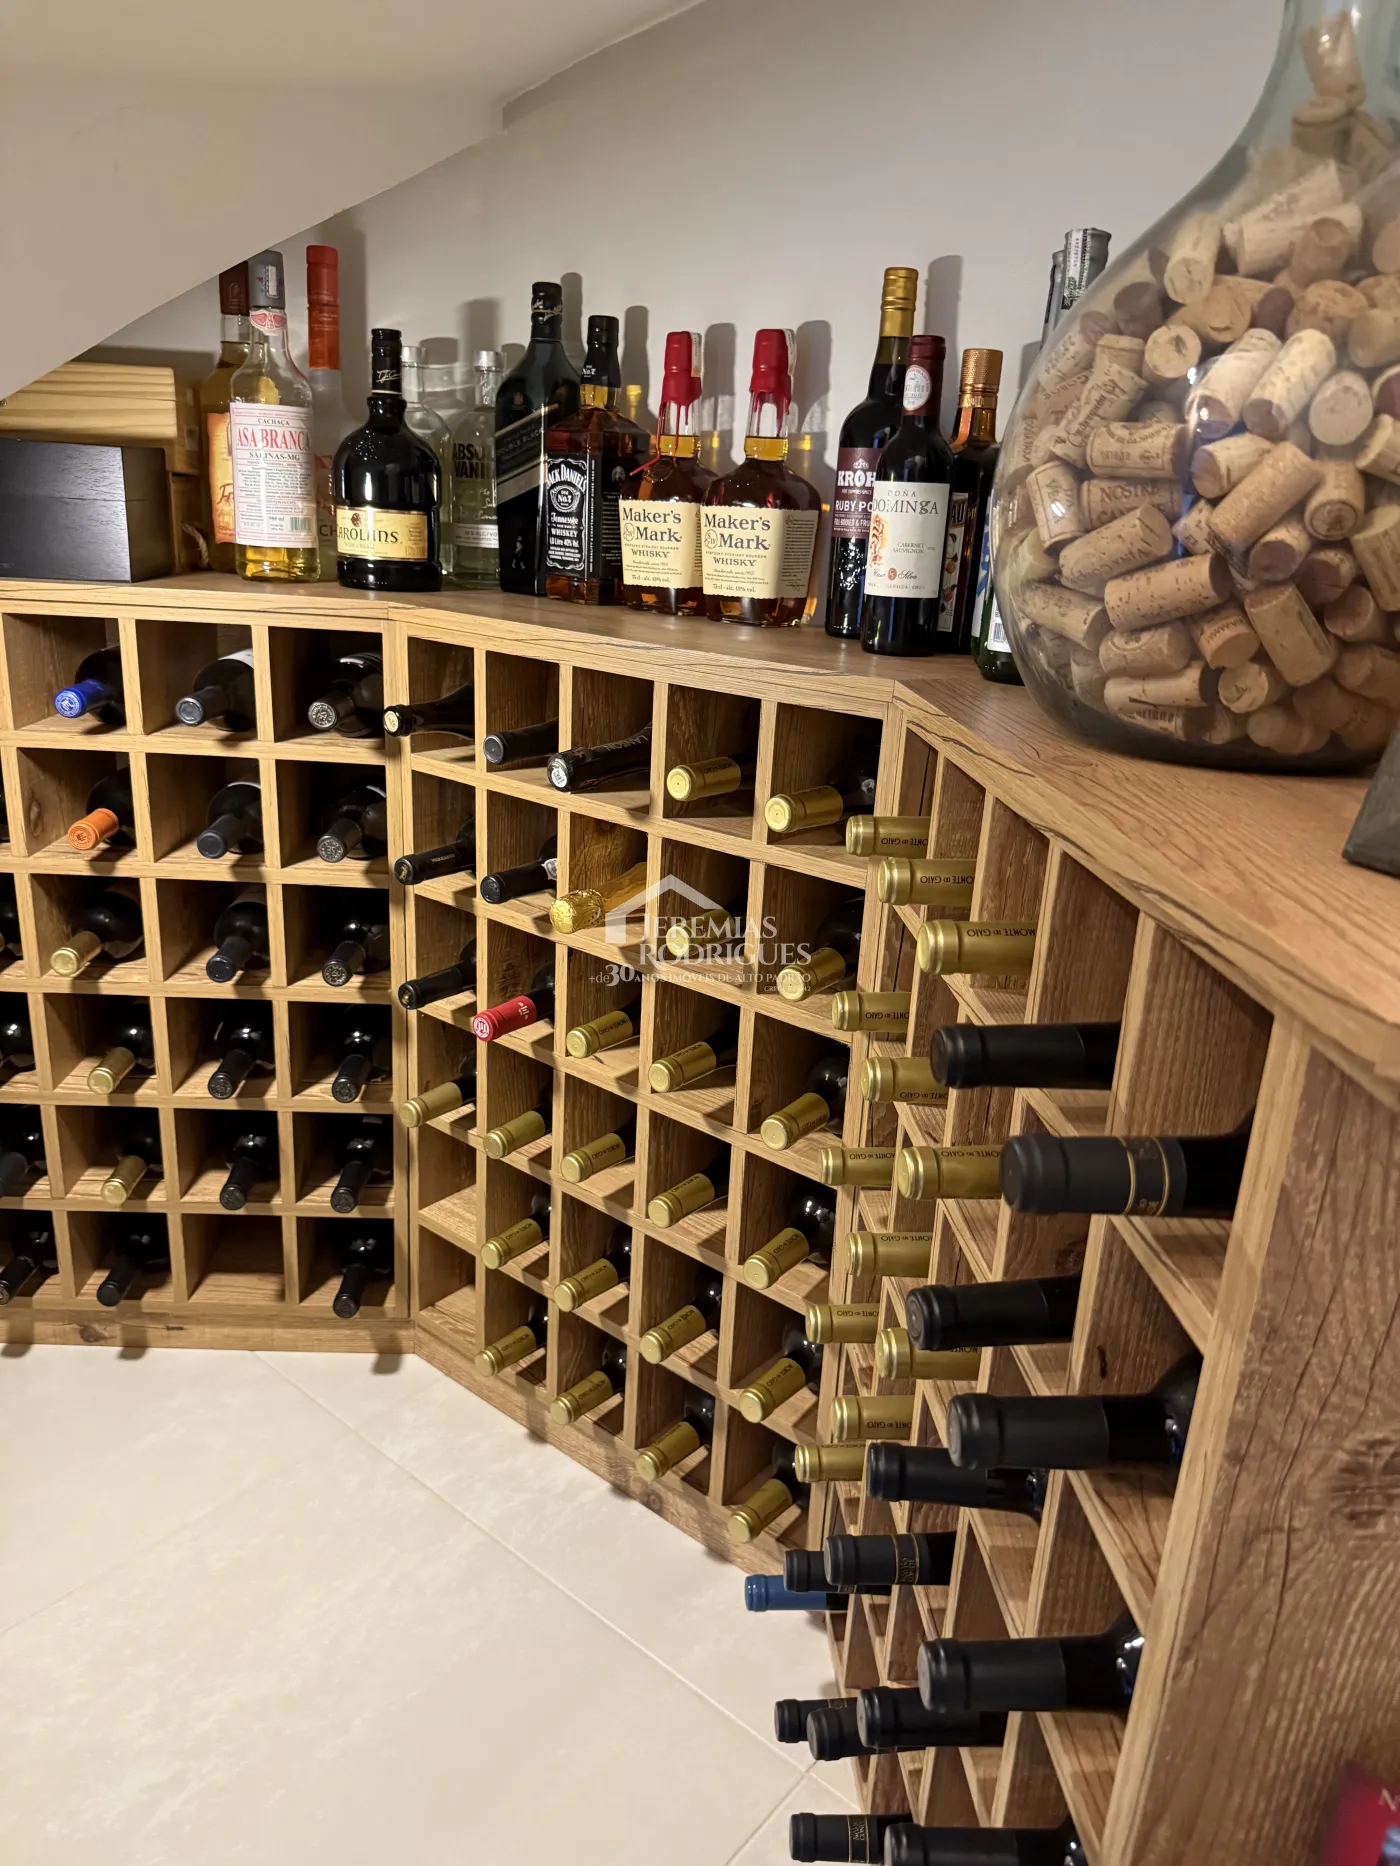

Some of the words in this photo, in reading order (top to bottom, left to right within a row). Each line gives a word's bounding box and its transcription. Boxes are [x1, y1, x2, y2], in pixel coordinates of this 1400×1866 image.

[257, 418, 290, 427] CACHAÇA
[237, 427, 258, 448] ASA
[260, 428, 311, 451] BRANCA
[249, 451, 300, 462] SAINAS-MG
[835, 500, 857, 512] RUBY
[622, 506, 682, 524] Maker's
[703, 513, 771, 531] Maker's
[550, 528, 578, 538] WHISKEY
[635, 525, 682, 542] Mark
[718, 533, 770, 550] Mark
[630, 549, 671, 558] WHISKY
[712, 556, 758, 567] WHISKY
[966, 928, 992, 938] GAIO
[1003, 928, 1036, 937] MONTE
[941, 1150, 965, 1158] GAIO
